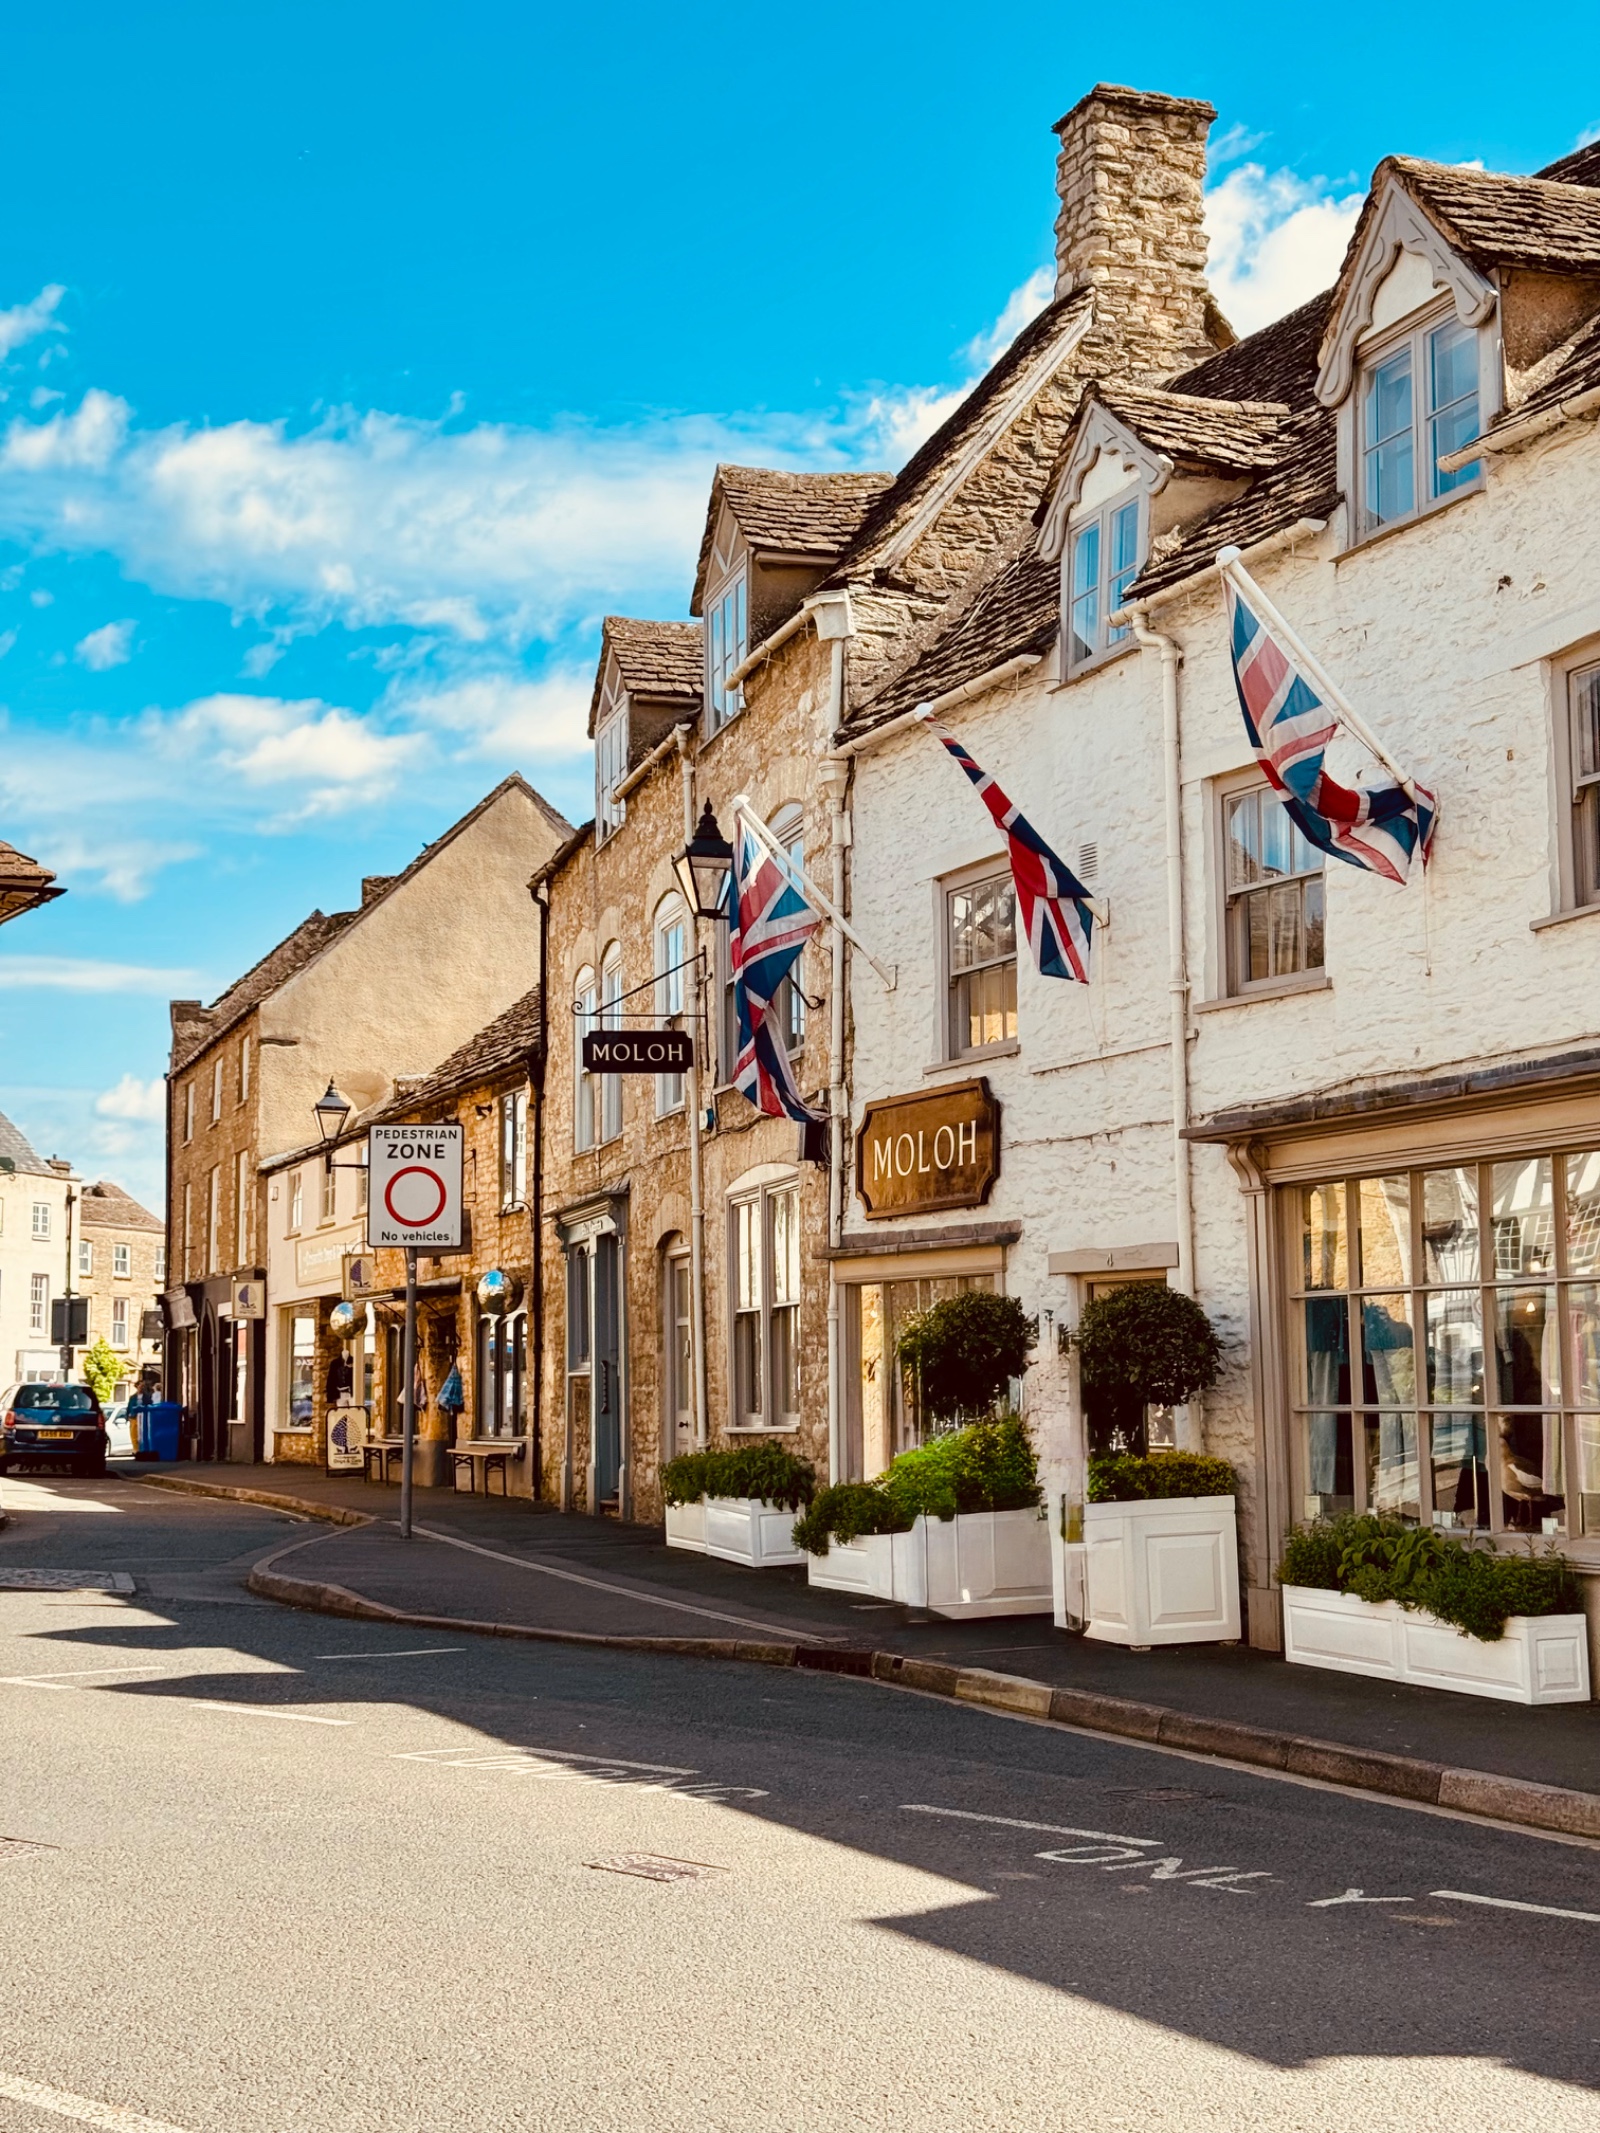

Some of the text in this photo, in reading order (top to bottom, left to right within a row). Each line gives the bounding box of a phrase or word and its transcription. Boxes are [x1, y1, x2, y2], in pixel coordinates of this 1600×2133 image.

[592, 1043, 683, 1062] MOLOH
[375, 1129, 458, 1140] PEDESTRIAN
[387, 1143, 446, 1159] ZONE
[873, 1119, 977, 1182] MOLOH
[381, 1231, 450, 1241] No vehicles
[388, 1746, 770, 1802] LOADING
[1034, 1845, 1415, 1907] ONLY
